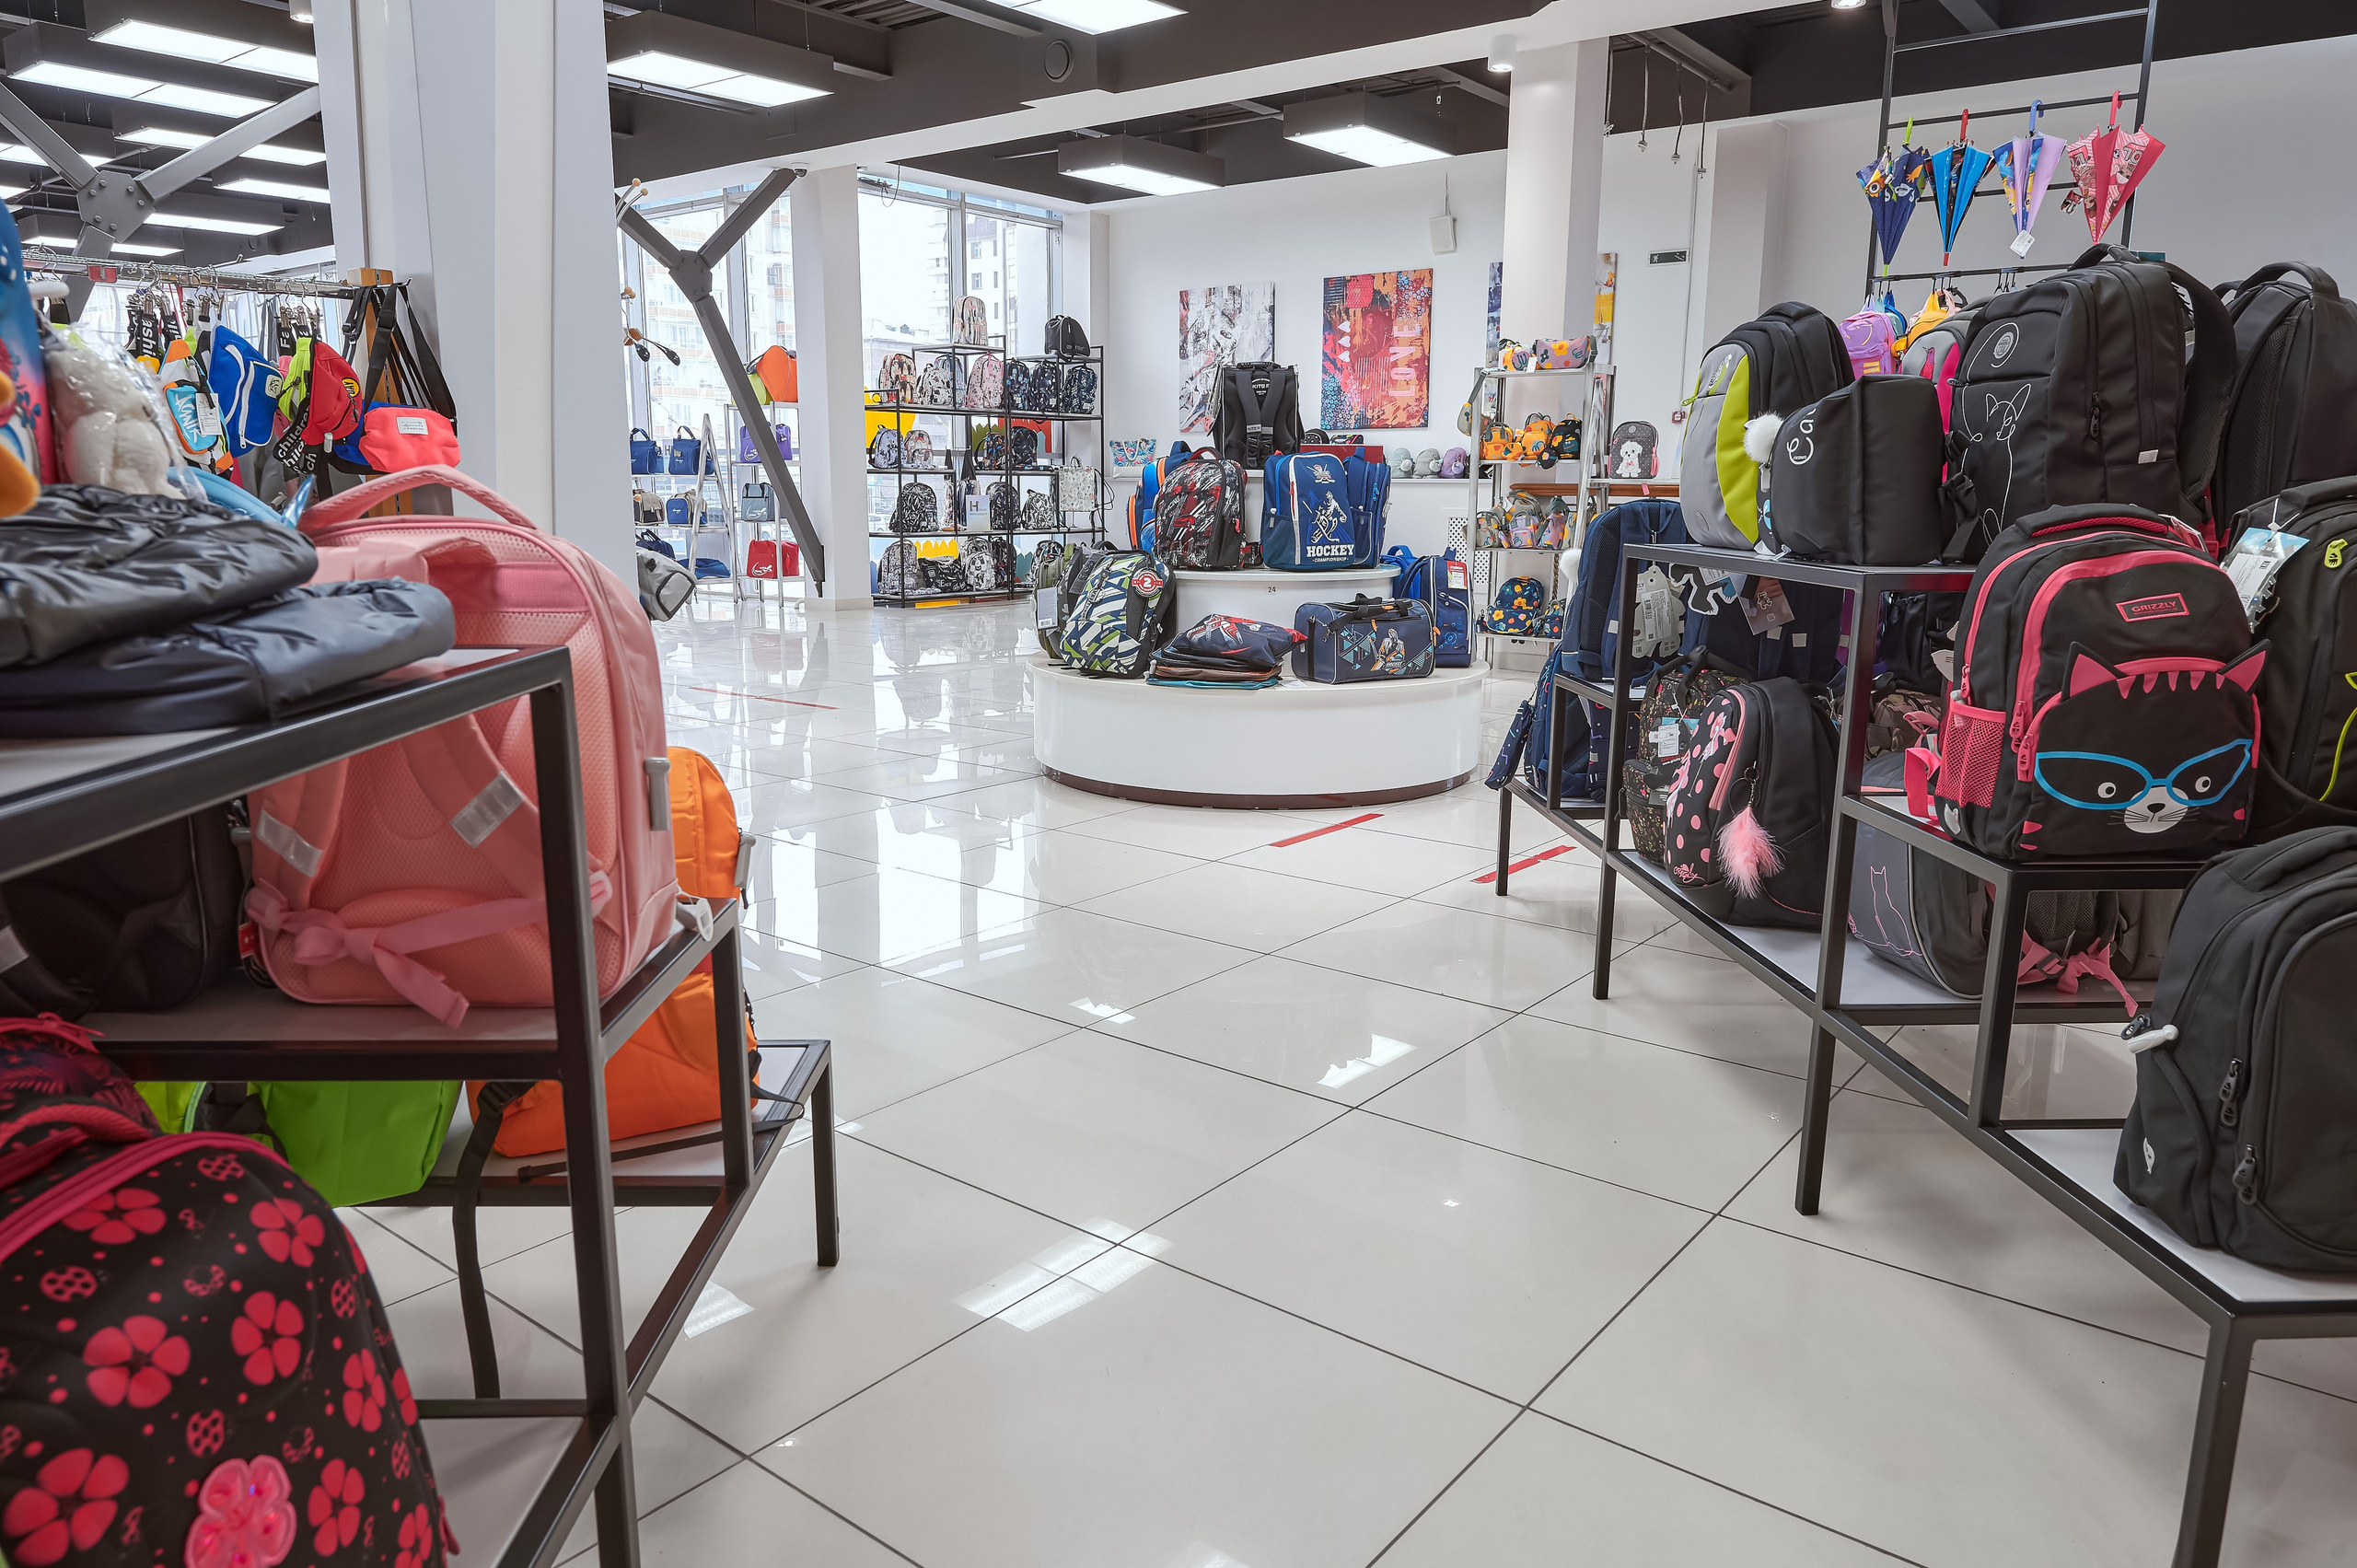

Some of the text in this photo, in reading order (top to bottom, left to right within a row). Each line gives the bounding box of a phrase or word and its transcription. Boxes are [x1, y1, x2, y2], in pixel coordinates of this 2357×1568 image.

[1389, 324, 1421, 397] LOVE
[278, 405, 310, 459] childre
[1306, 544, 1354, 557] HOCKEY
[1143, 577, 1152, 587] 2
[2131, 600, 2177, 613] GRIZZLY
